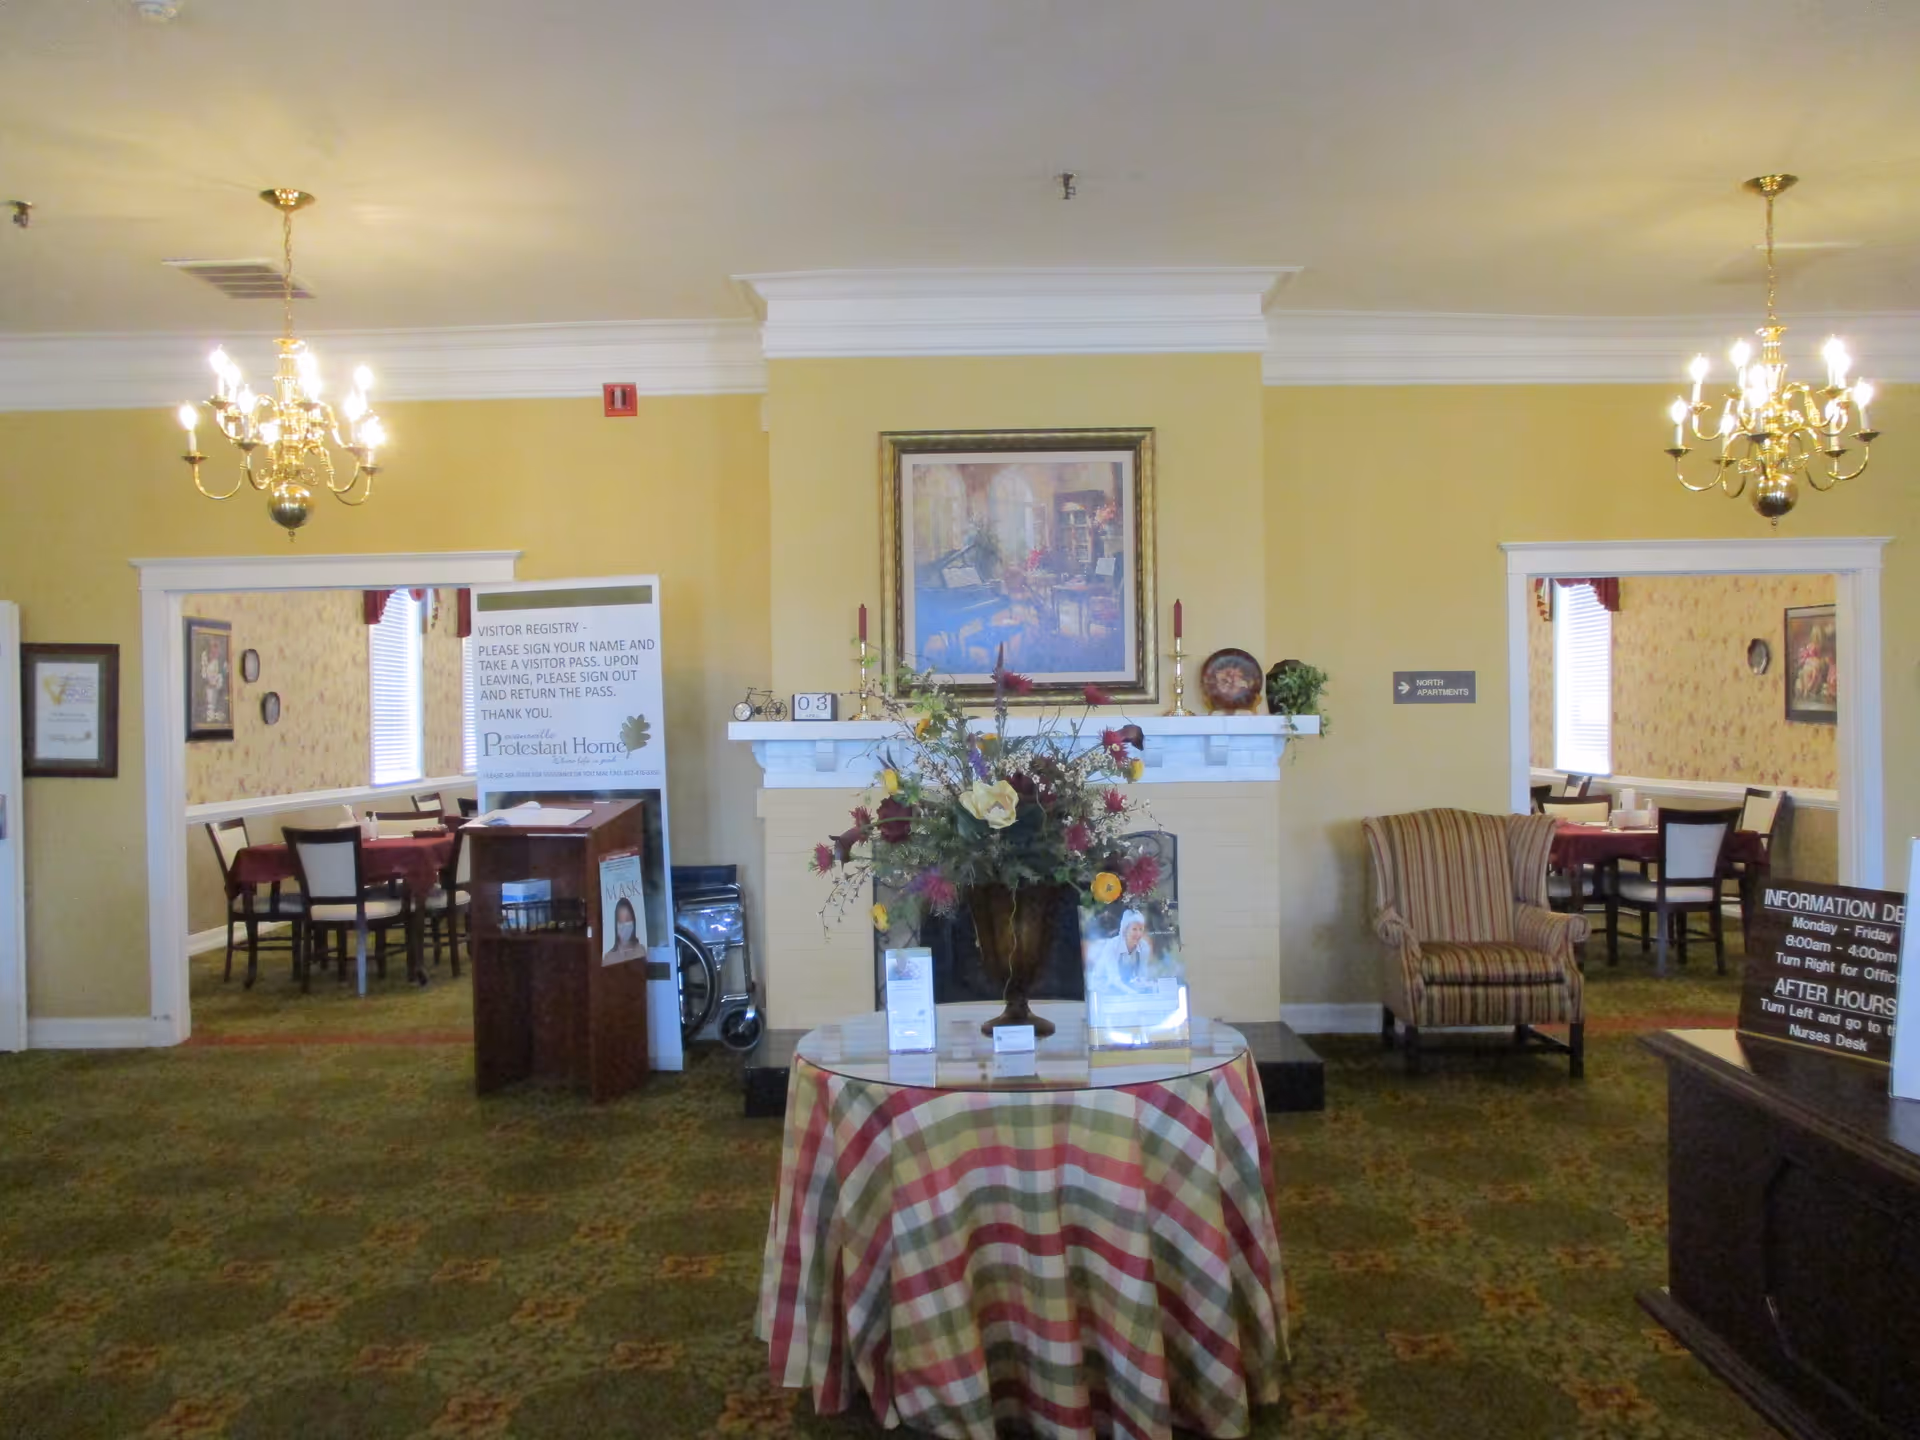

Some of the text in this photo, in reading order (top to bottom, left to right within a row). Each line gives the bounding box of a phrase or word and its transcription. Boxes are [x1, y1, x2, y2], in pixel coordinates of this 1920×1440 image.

[478, 624, 522, 637] VISITOR
[526, 622, 579, 635] REGISTRY
[478, 638, 655, 657] PLEASE SIGN YOUR NAME AND
[478, 655, 639, 671] TAKE A VISITOR PASS. UPON
[480, 670, 637, 687] LEAVING, PLEASE SIGN OUT
[480, 685, 617, 701] AND RETURN THE PASS.
[1416, 688, 1469, 696] APARTMENTS
[480, 707, 552, 721] THANK YOU.
[483, 731, 626, 757] Protestant Home
[605, 880, 641, 901] MASK
[1764, 888, 1907, 924] INFORMATION DE
[1792, 916, 1838, 936] Monday
[1854, 924, 1894, 944] Friday
[1785, 934, 1832, 953] 8:00am
[1848, 944, 1898, 964] 4:00pm
[1775, 951, 1801, 968] Turn
[1804, 956, 1836, 974] Right
[1841, 963, 1859, 977] for
[1774, 977, 1897, 1017] AFTER HOURS
[1760, 997, 1785, 1014] Turn
[1789, 1004, 1813, 1020] Left
[1817, 1011, 1841, 1026] and
[1845, 1018, 1862, 1030] go
[1867, 1020, 1881, 1034] to
[1788, 1023, 1869, 1052] Nurses Desk
